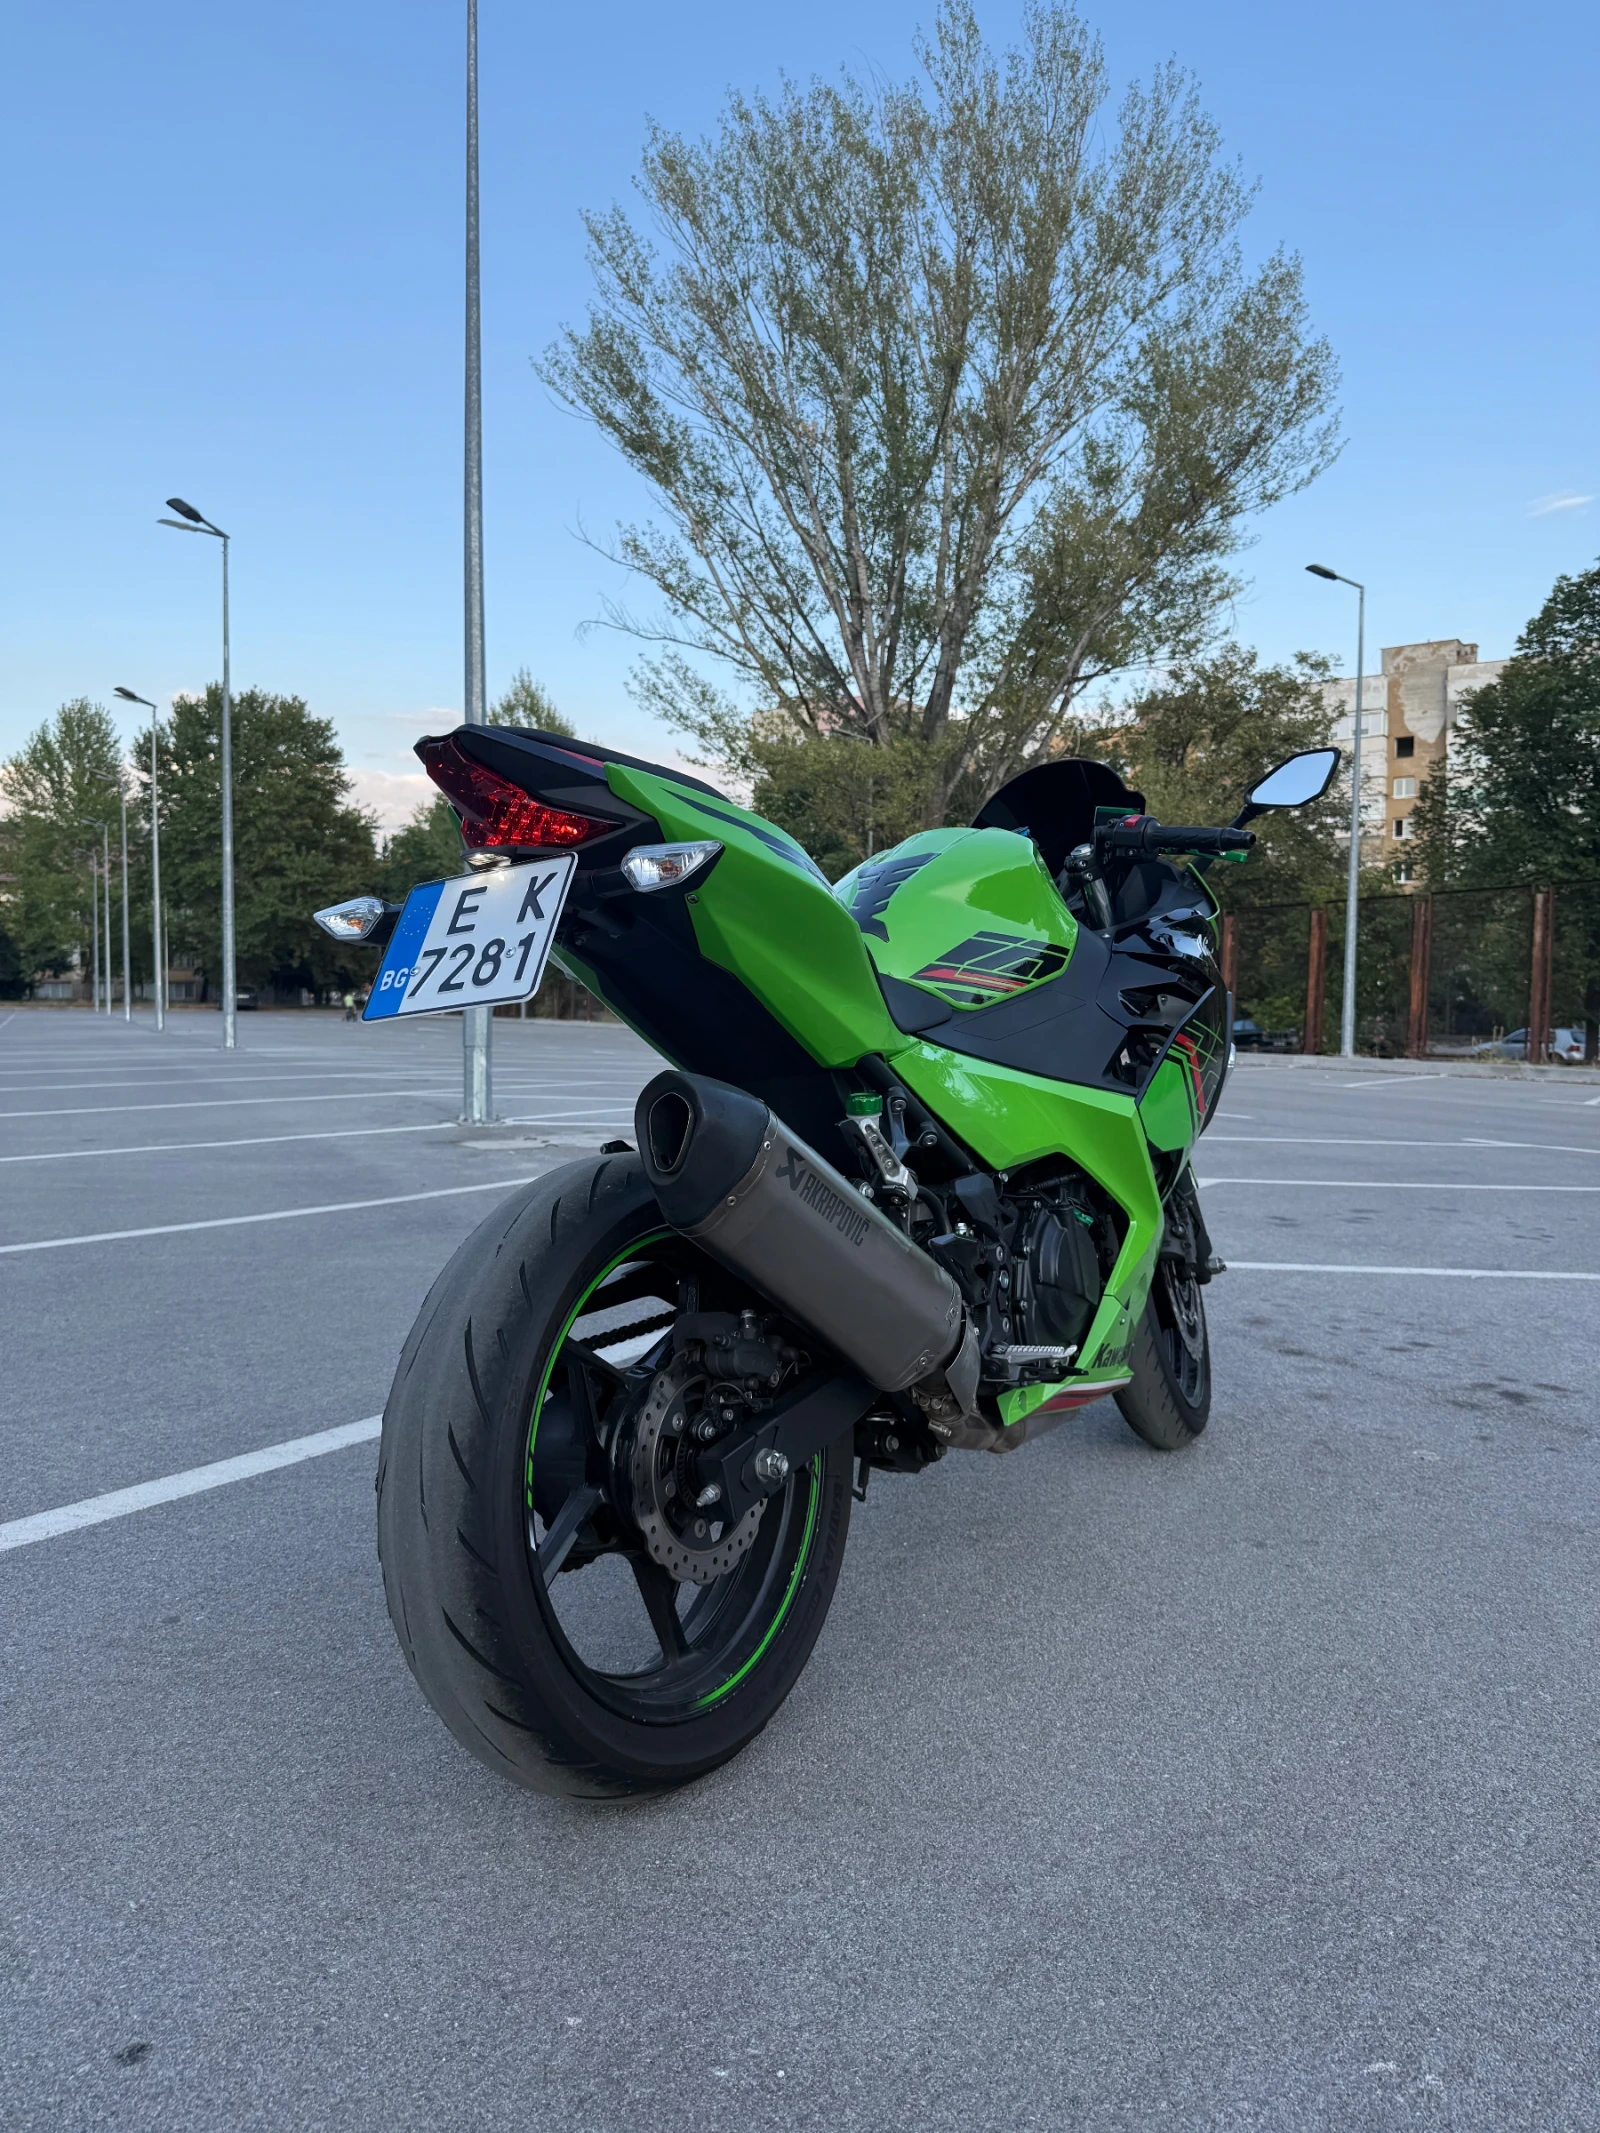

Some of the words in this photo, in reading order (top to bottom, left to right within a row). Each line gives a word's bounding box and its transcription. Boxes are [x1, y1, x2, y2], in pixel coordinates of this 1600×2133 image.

[446, 885, 488, 936] E
[516, 871, 559, 924] K
[379, 967, 410, 991] BG
[407, 931, 537, 999] 7281
